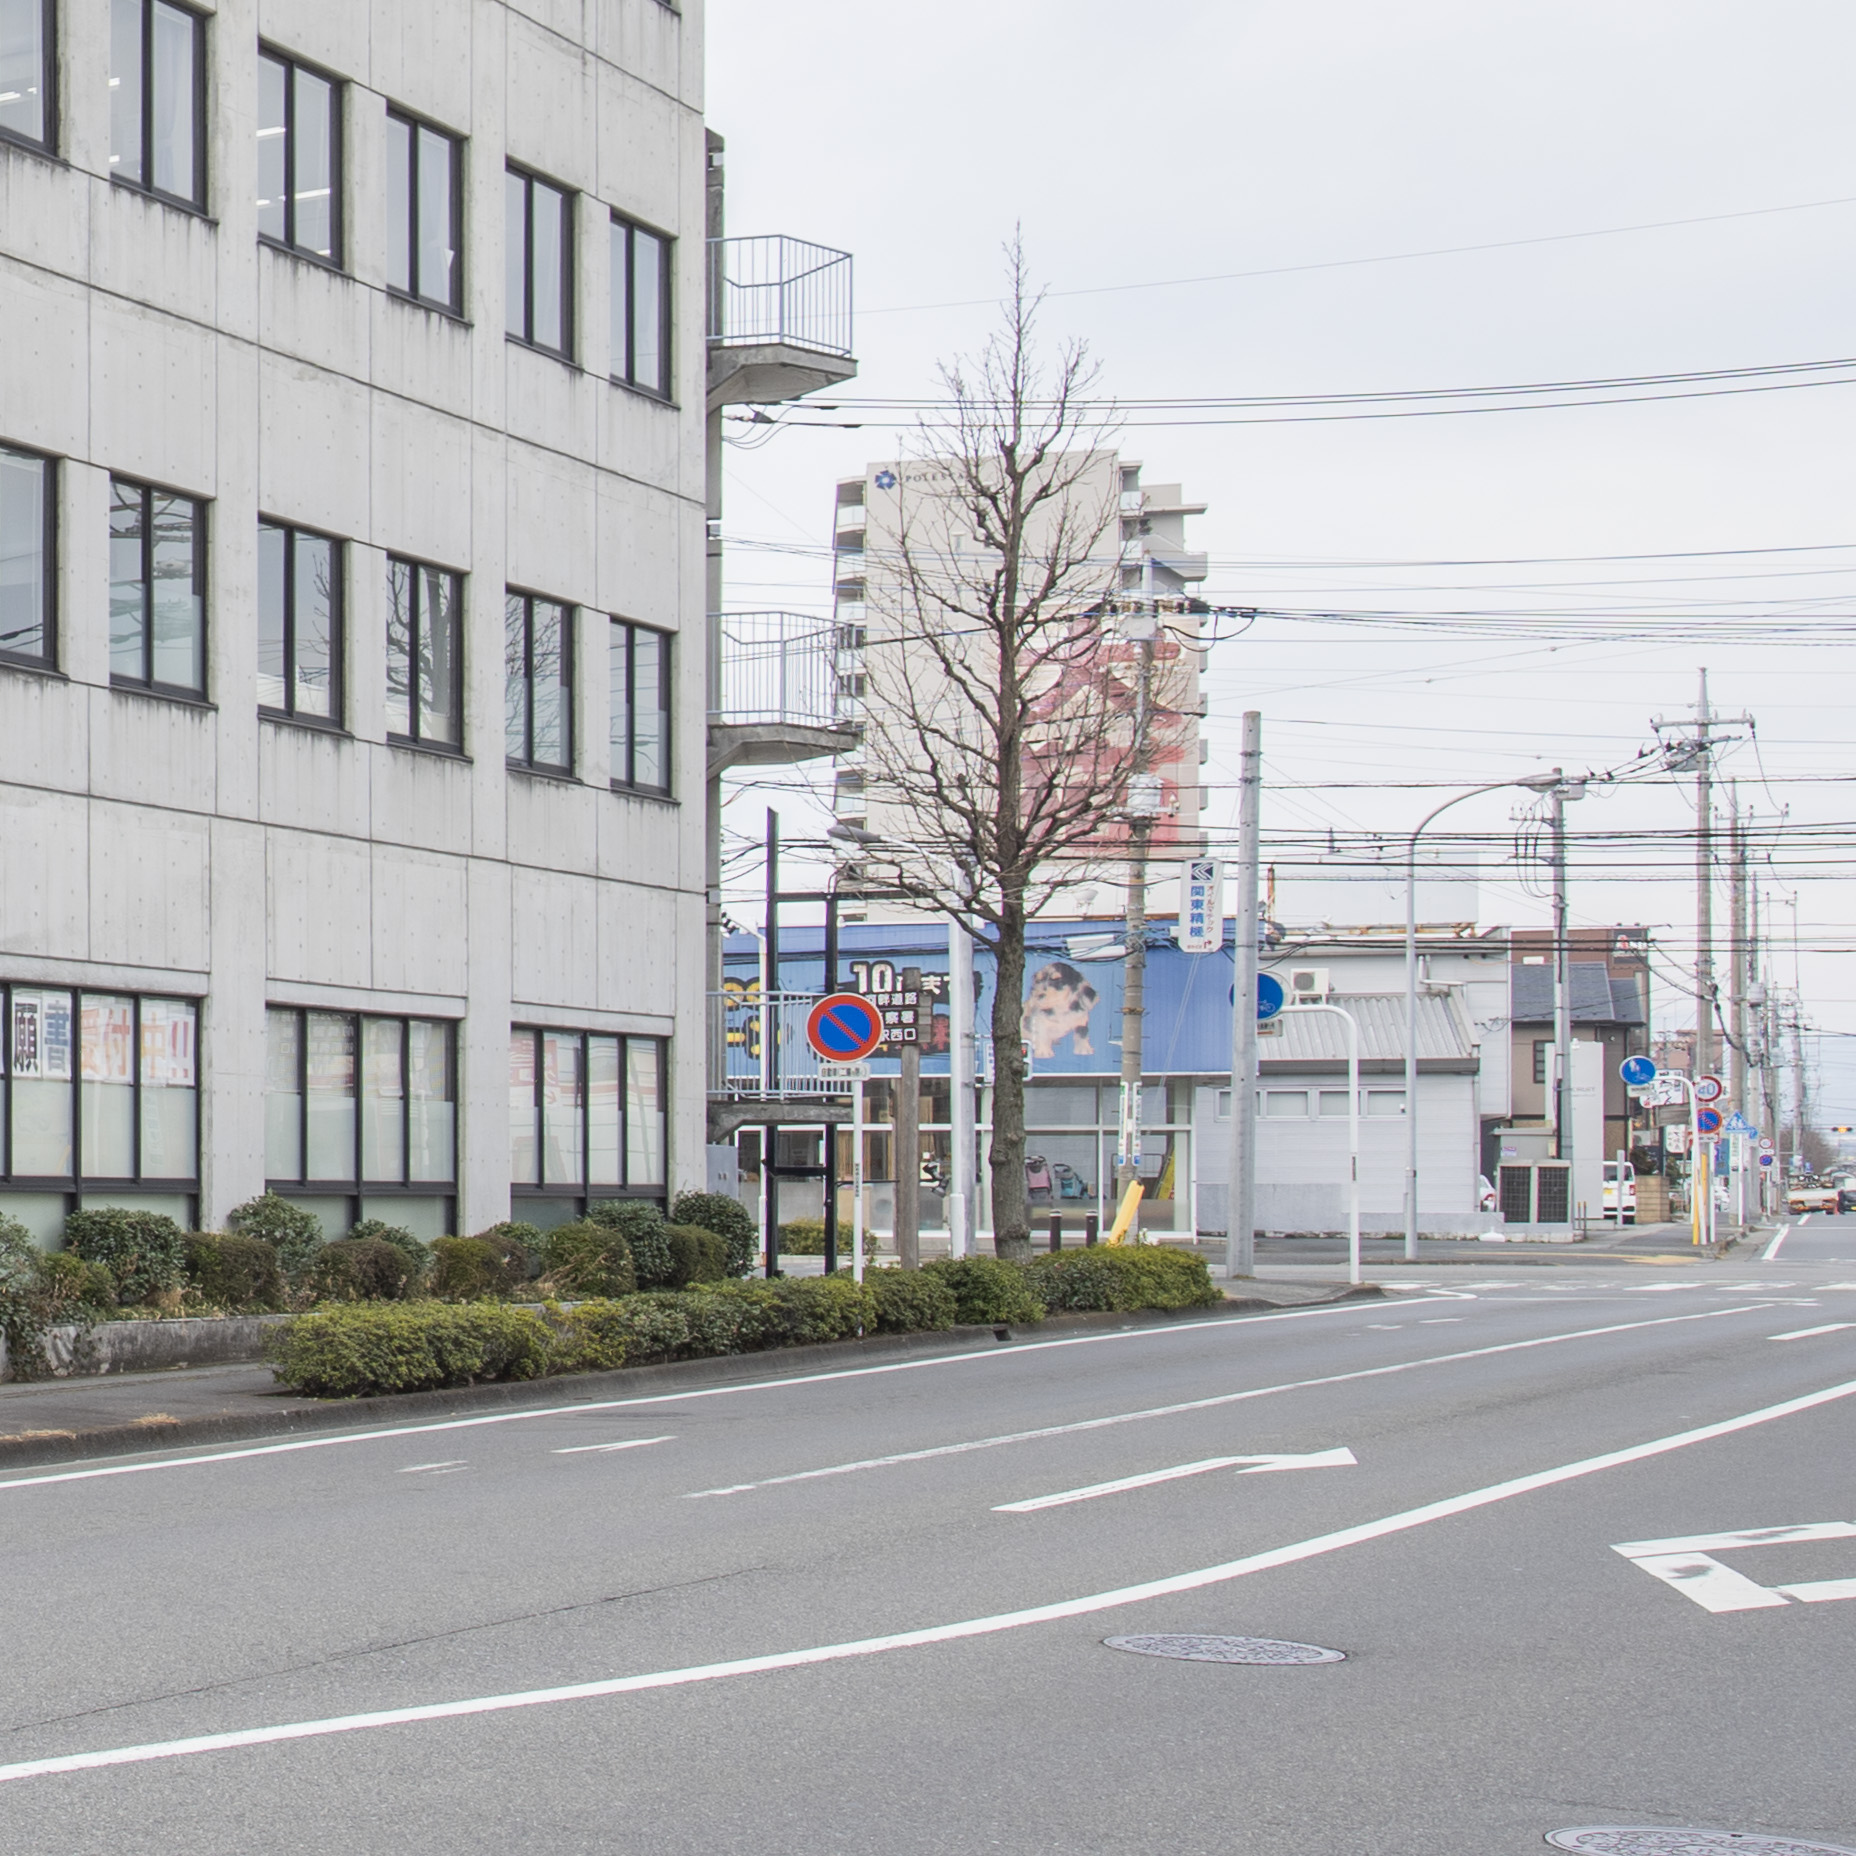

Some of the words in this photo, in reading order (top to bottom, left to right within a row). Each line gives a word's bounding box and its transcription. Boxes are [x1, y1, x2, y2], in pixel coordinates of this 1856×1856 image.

[853, 963, 950, 994] 10ま
[881, 1010, 915, 1024] 察署
[1698, 1083, 1716, 1096] 40
